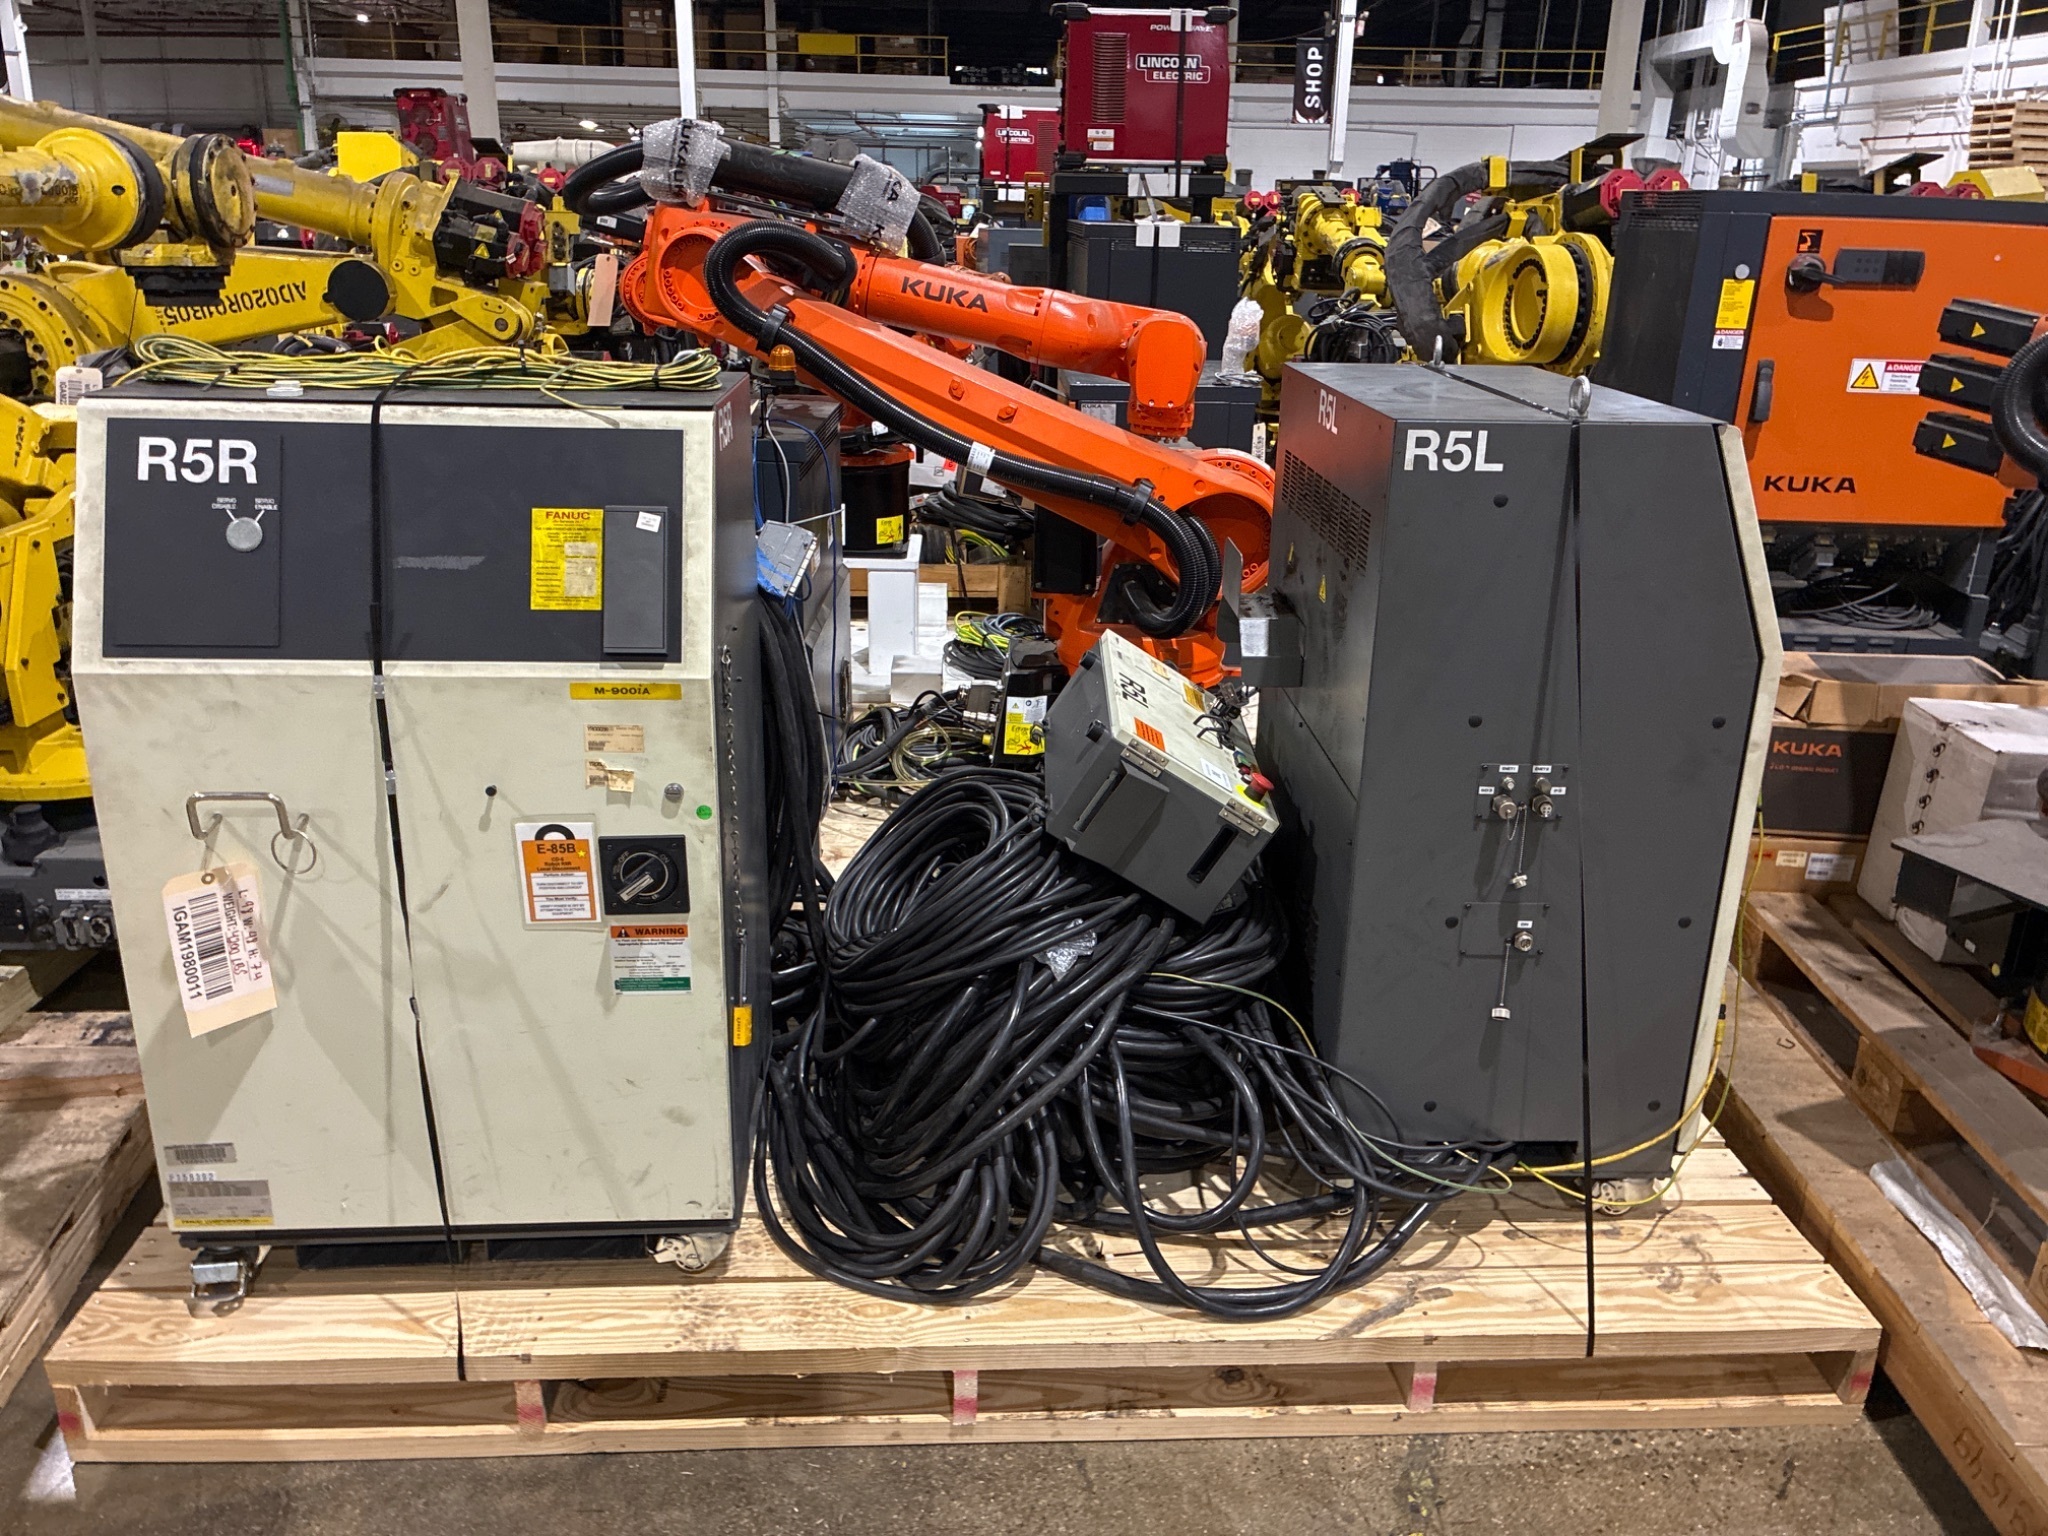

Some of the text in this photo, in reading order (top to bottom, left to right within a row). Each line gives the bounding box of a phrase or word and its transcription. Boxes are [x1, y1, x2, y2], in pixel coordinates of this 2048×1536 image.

[1140, 57, 1198, 69] LINCON
[1304, 46, 1324, 109] SHOP
[901, 276, 989, 313] KUKA
[1318, 388, 1339, 436] R5L
[137, 436, 258, 484] R5R
[1404, 429, 1504, 472] R5L
[1763, 475, 1856, 494] KUKA
[545, 511, 591, 520] FANUC
[1118, 672, 1149, 709] R5L
[1773, 740, 1843, 758] KUKA
[536, 843, 576, 854] E-85B
[223, 892, 238, 931] WEIGHT:
[634, 927, 685, 935] WARNING
[171, 905, 203, 1000] IGAM1980011
[248, 949, 260, 960] H:
